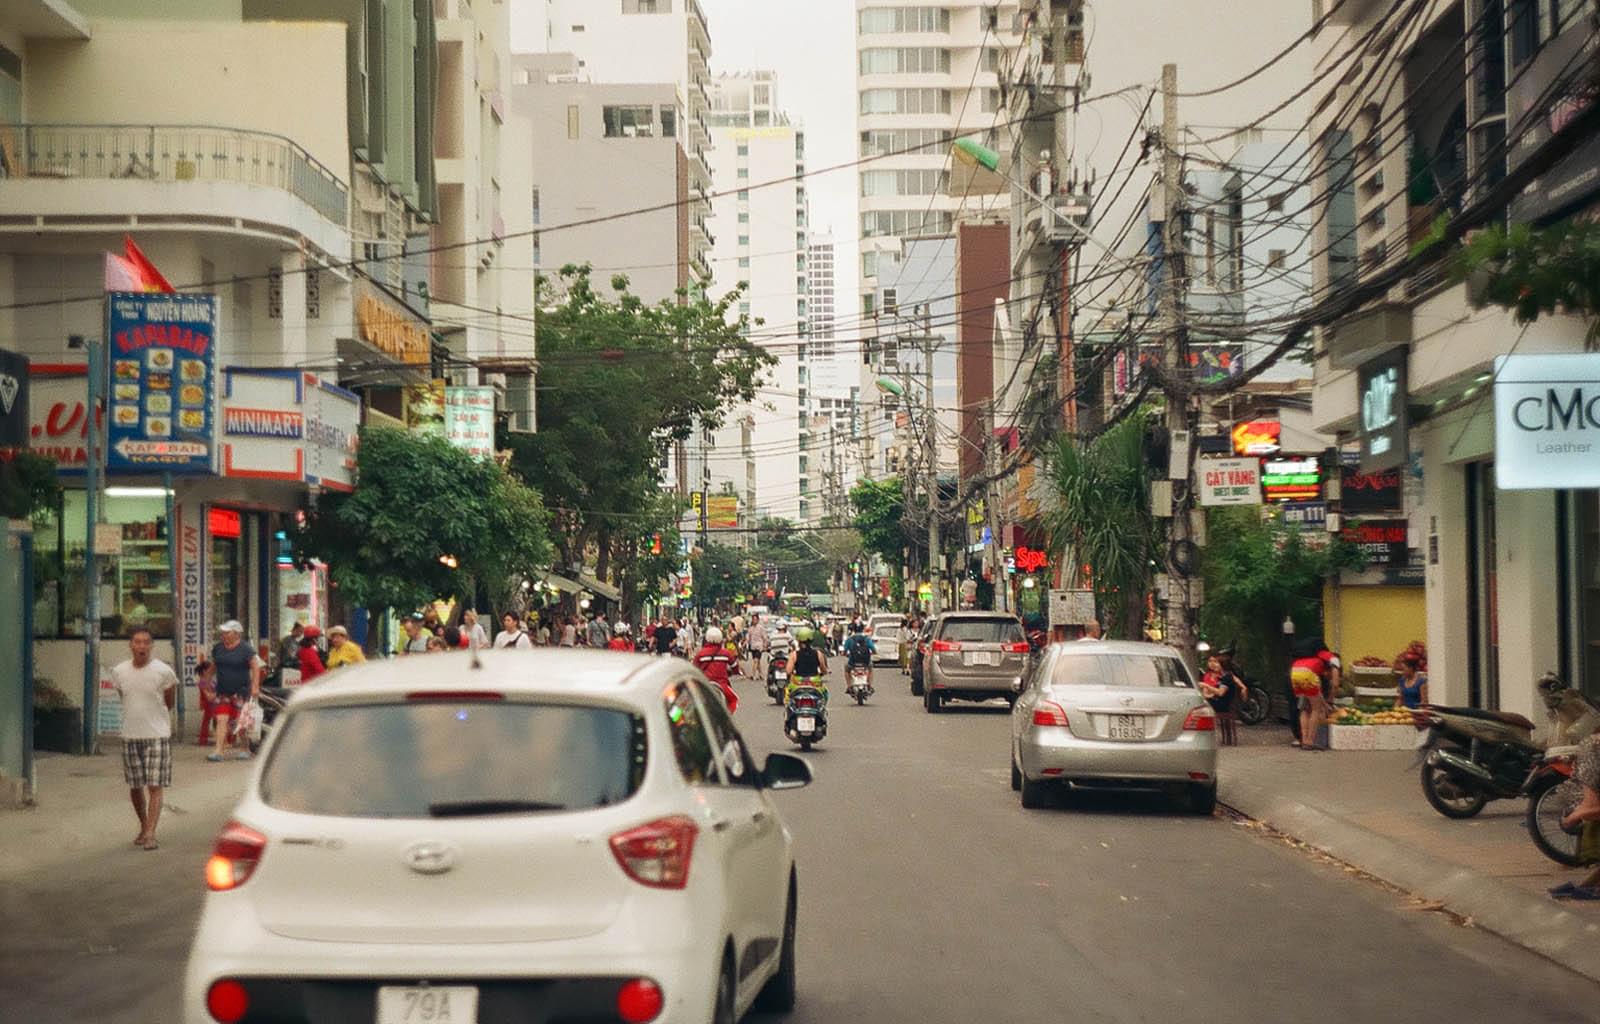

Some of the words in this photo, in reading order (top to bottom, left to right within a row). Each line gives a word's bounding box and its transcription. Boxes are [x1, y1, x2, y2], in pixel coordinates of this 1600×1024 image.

[227, 410, 302, 436] MINIMART
[1537, 442, 1592, 454] Leather
[1306, 507, 1325, 521] 111
[404, 990, 450, 1021] 79A
